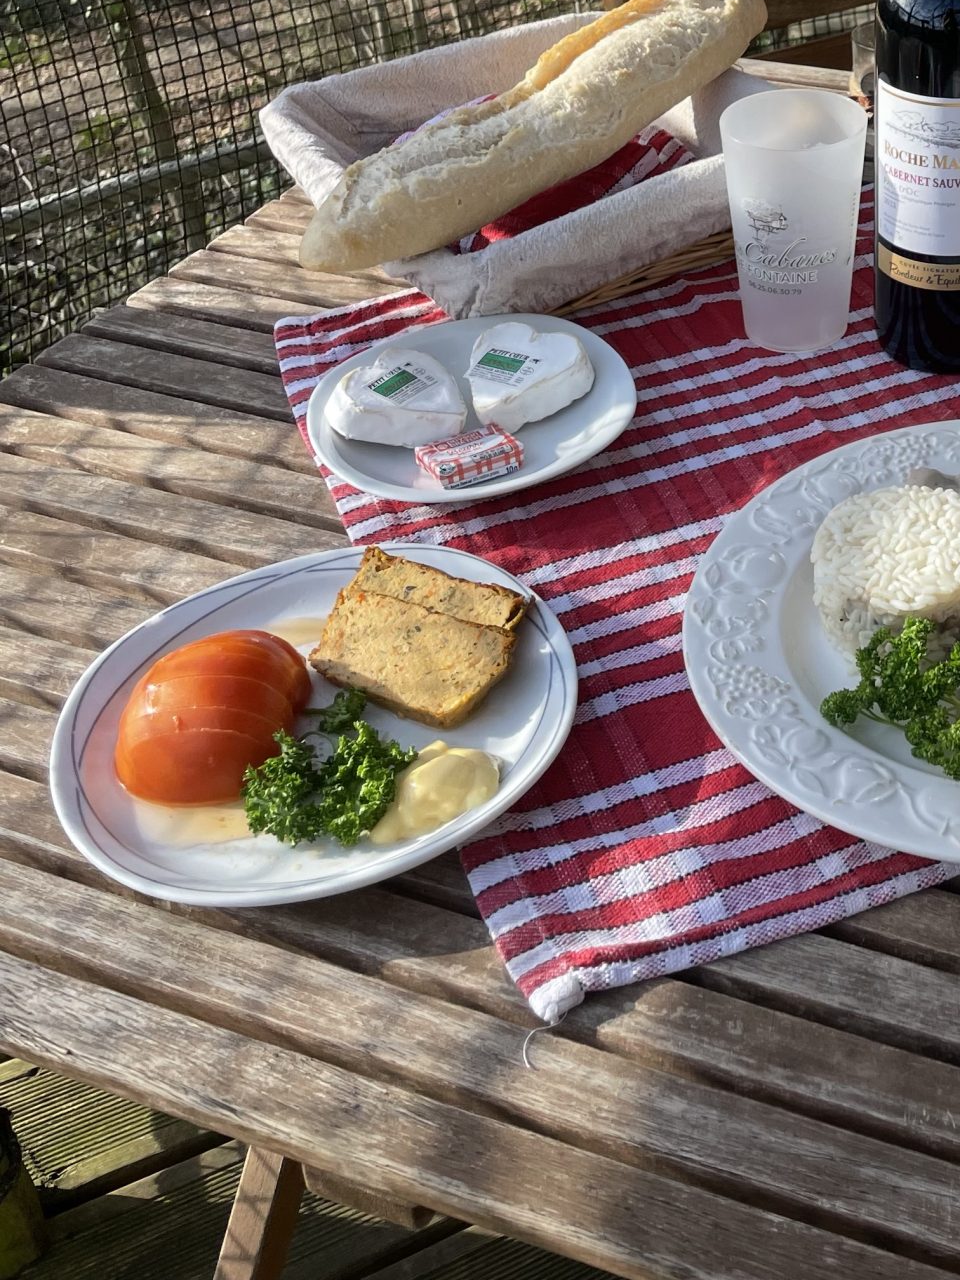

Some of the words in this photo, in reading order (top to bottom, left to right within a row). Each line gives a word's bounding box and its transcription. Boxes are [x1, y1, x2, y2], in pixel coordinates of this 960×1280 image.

[884, 140, 929, 167] ROCHE
[883, 163, 932, 187] CABERNET
[745, 238, 838, 268] Cabanes
[889, 261, 923, 282] Rondeur
